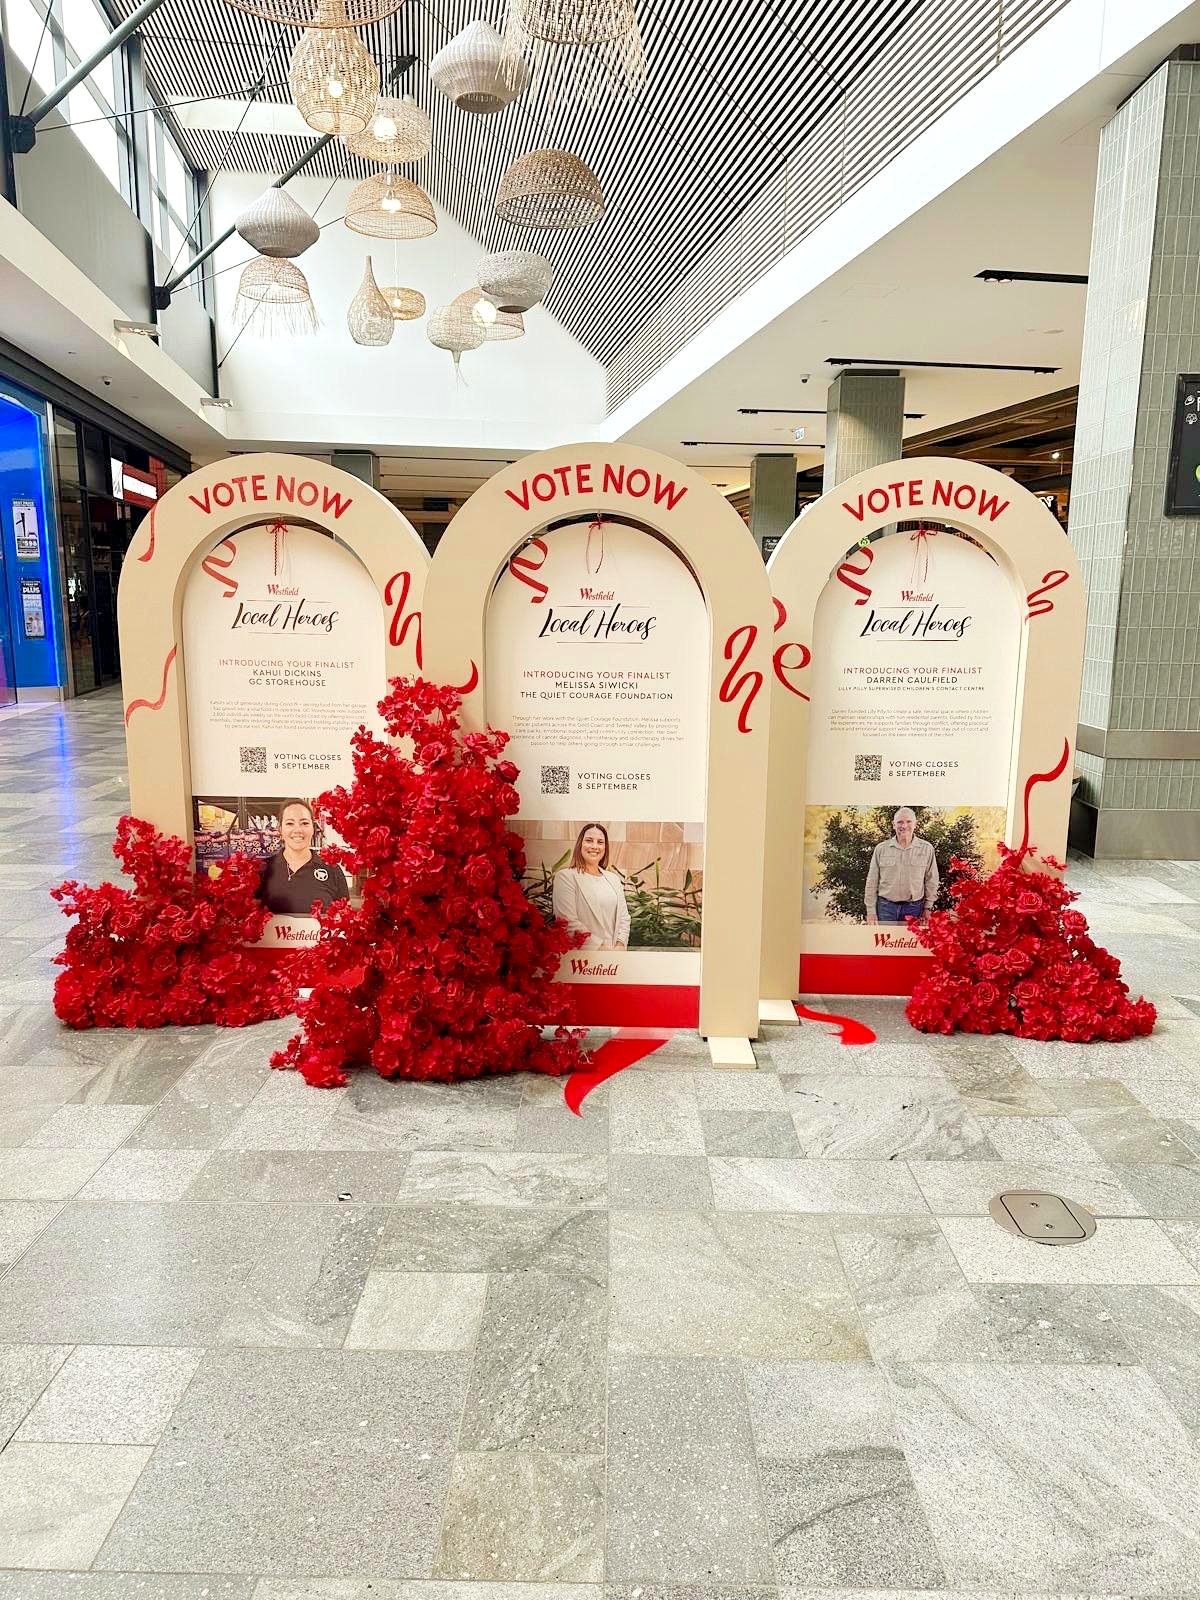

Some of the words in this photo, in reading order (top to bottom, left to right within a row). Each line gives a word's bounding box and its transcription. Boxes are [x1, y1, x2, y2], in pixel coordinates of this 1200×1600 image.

[504, 463, 594, 511] VOTE
[602, 463, 688, 511] NOW
[188, 474, 268, 514] VOTE
[276, 475, 353, 519] NOW
[842, 480, 924, 522] VOTE
[932, 480, 1010, 522] NOW
[267, 584, 299, 596] Westfield
[580, 588, 615, 600] Westfield
[901, 590, 934, 602] Westfield
[231, 602, 282, 630] Local
[282, 598, 339, 632] Heroes
[538, 608, 595, 638] Local
[594, 603, 656, 640] Heroes
[860, 609, 914, 638] Local
[912, 604, 972, 638] Heroes
[219, 659, 284, 667] INTRODUCING
[523, 671, 594, 679] INTRODUCING
[274, 926, 320, 941] Westfield
[874, 933, 918, 949] Westfield
[570, 959, 619, 976] Westfield
